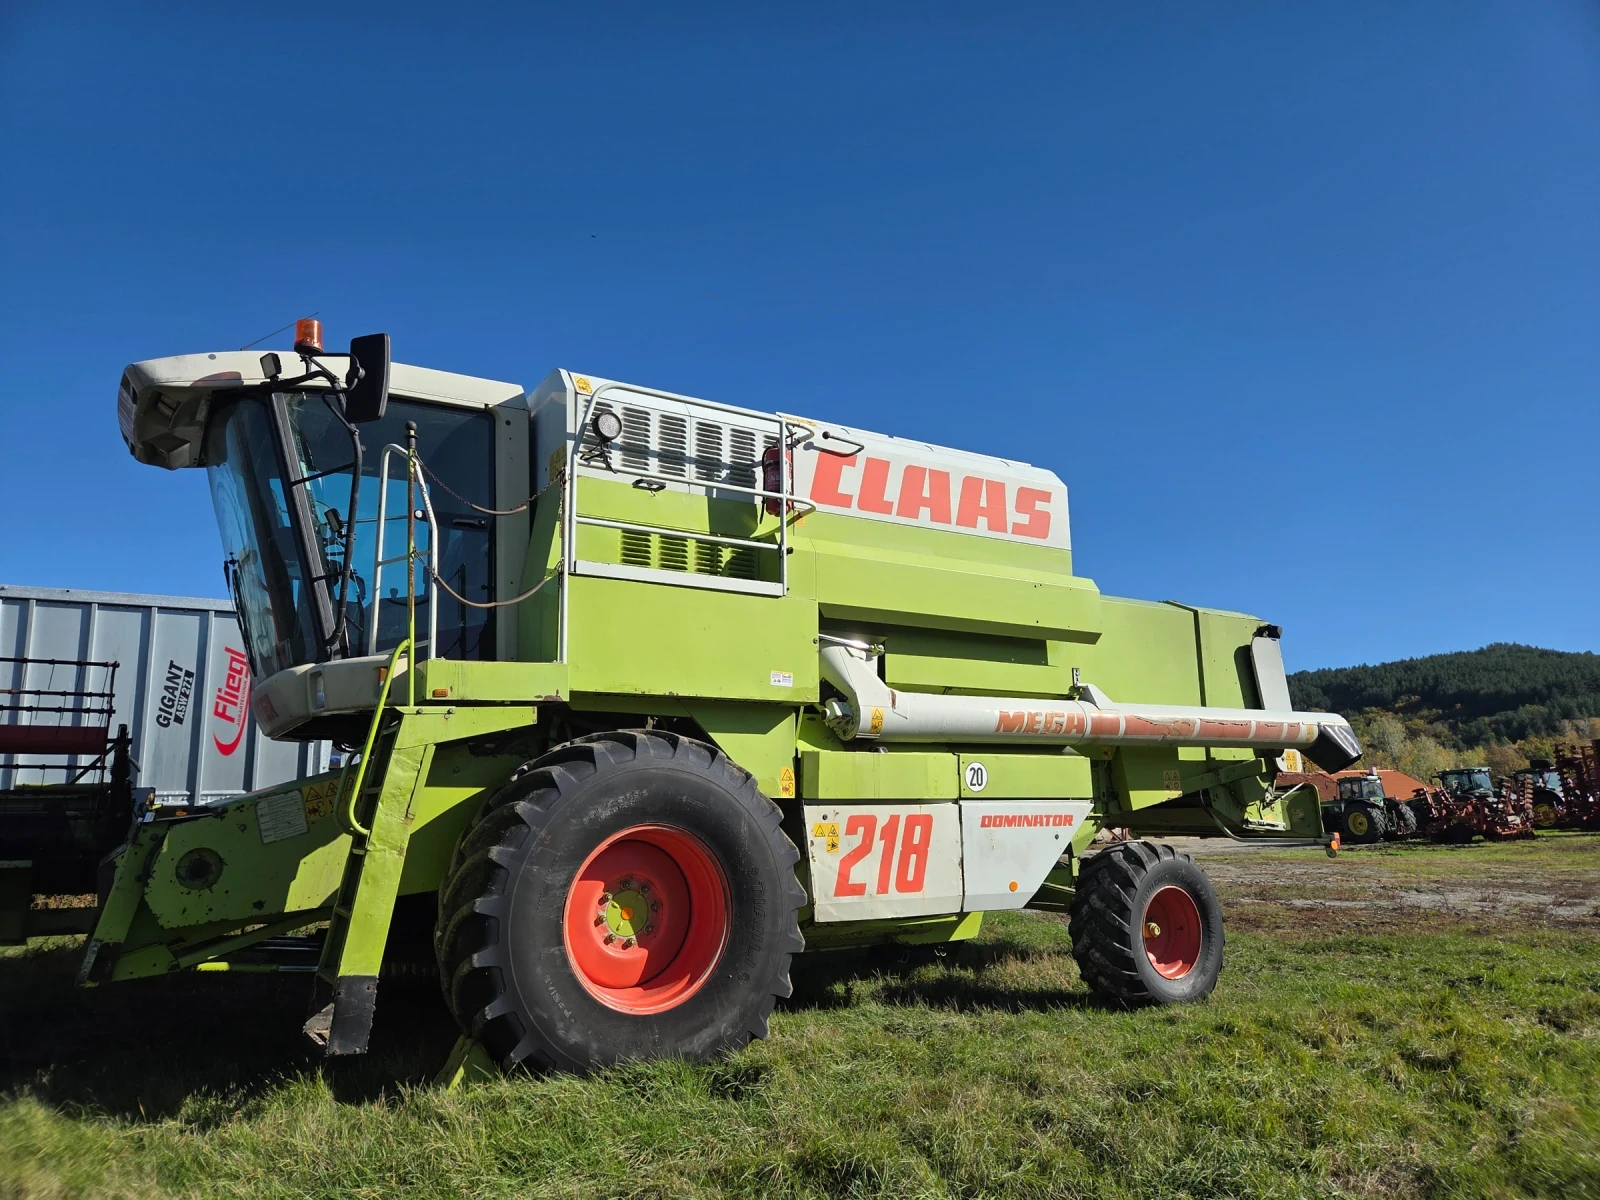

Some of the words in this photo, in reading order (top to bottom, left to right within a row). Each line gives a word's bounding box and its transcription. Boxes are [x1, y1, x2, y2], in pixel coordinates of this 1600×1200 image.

[810, 451, 1053, 540] CLAAS
[156, 660, 184, 728] GIGANT
[176, 696, 188, 719] ASW
[182, 676, 193, 696] 271
[213, 646, 249, 724] Fliegl
[994, 711, 1084, 734] MEGA
[969, 766, 984, 787] 20
[980, 814, 1074, 828] DOMINATOR
[834, 813, 934, 897] 218
